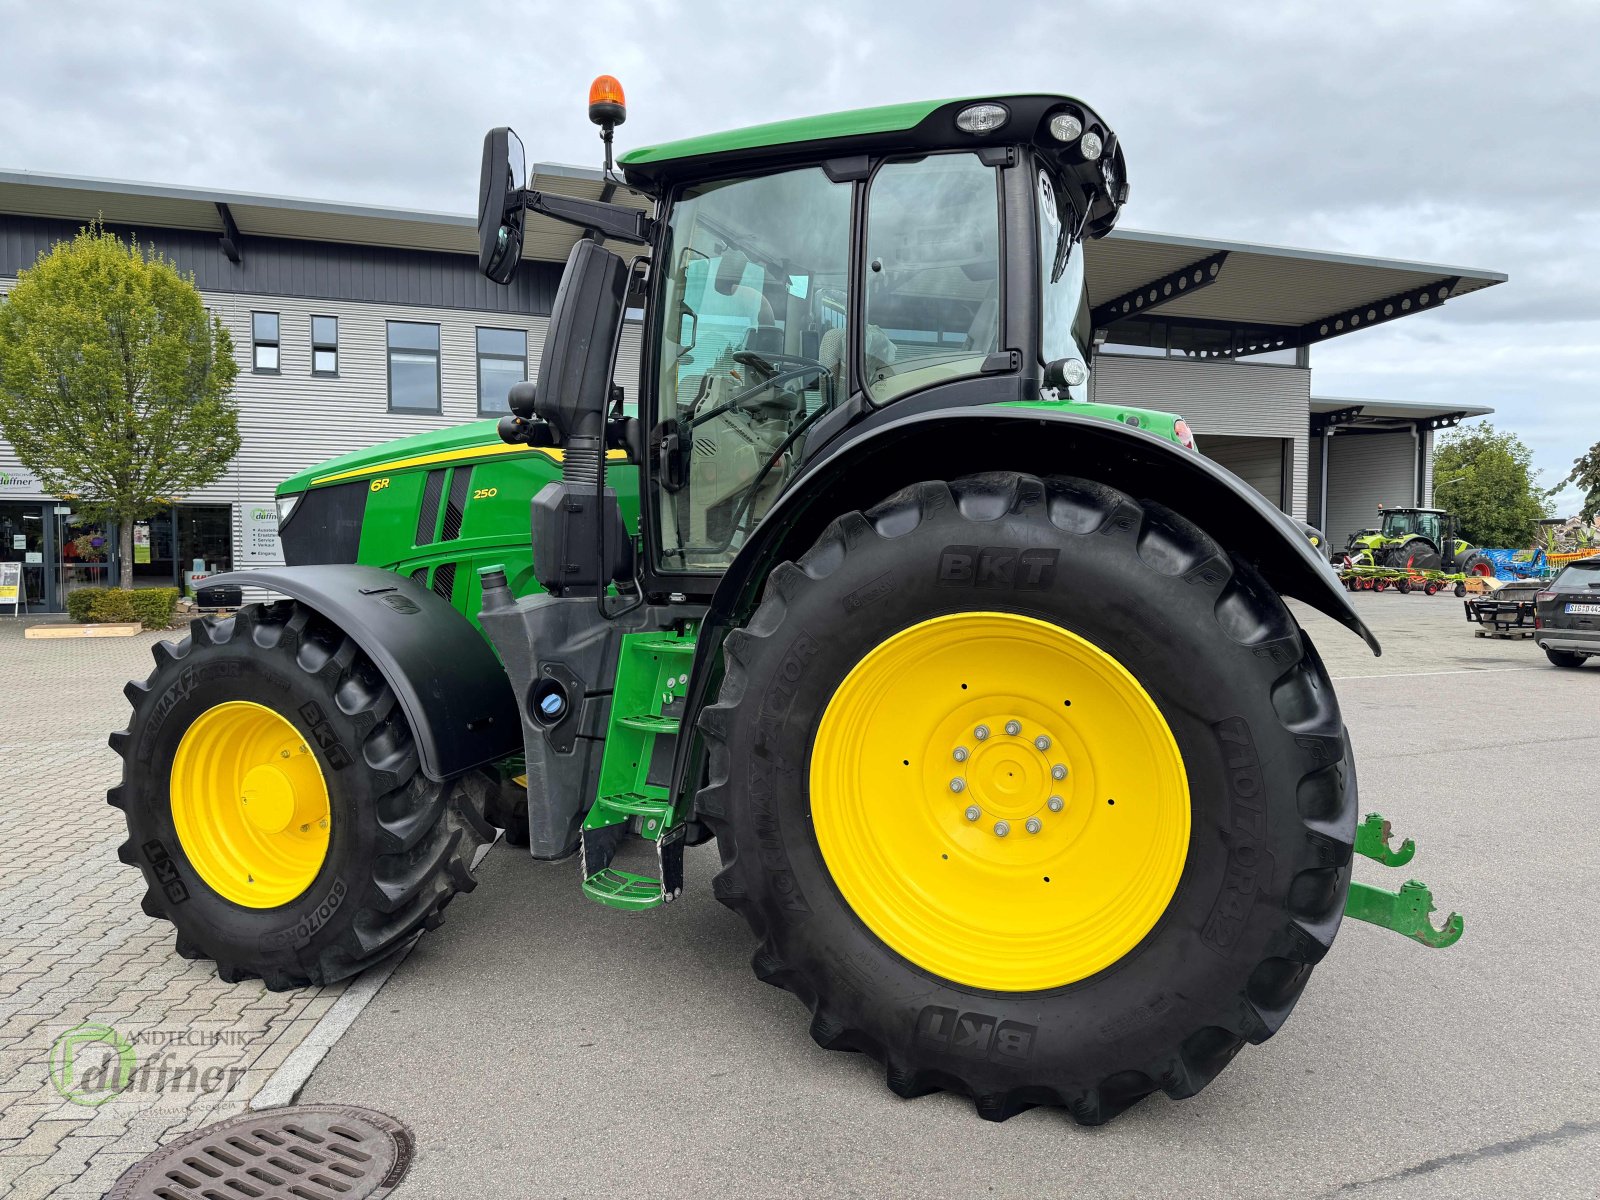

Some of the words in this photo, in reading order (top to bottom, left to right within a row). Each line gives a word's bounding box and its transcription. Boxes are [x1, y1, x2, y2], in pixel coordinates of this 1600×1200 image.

[370, 477, 390, 492] 6R
[472, 487, 498, 500] 250
[936, 546, 1060, 592] BKT
[300, 701, 354, 771] BKT
[143, 838, 189, 904] BKT
[918, 1009, 1034, 1061] BKT
